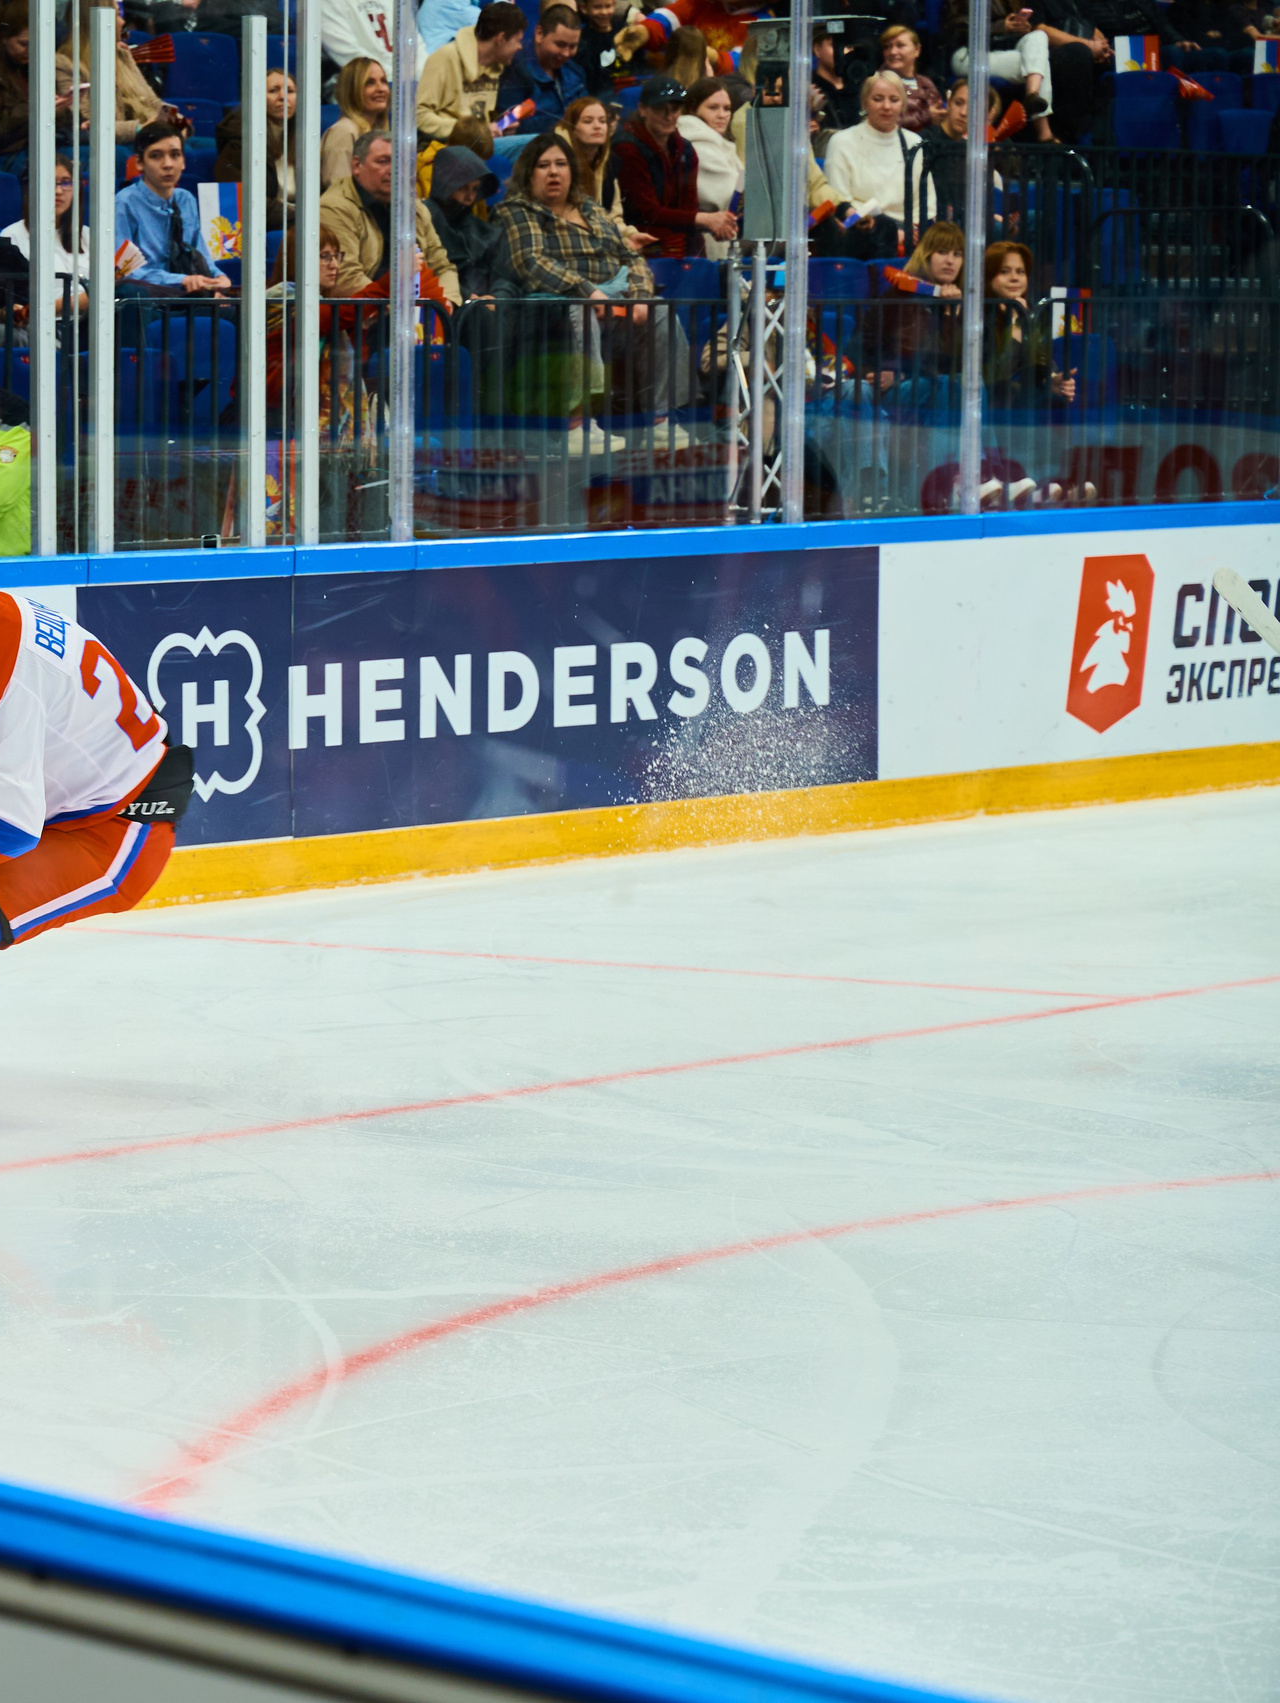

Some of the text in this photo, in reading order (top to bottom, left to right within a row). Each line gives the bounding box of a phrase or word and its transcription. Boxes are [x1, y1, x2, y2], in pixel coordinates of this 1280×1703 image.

[182, 679, 230, 748] H
[288, 629, 831, 750] HENDERSON
[117, 801, 175, 815] YUZ
